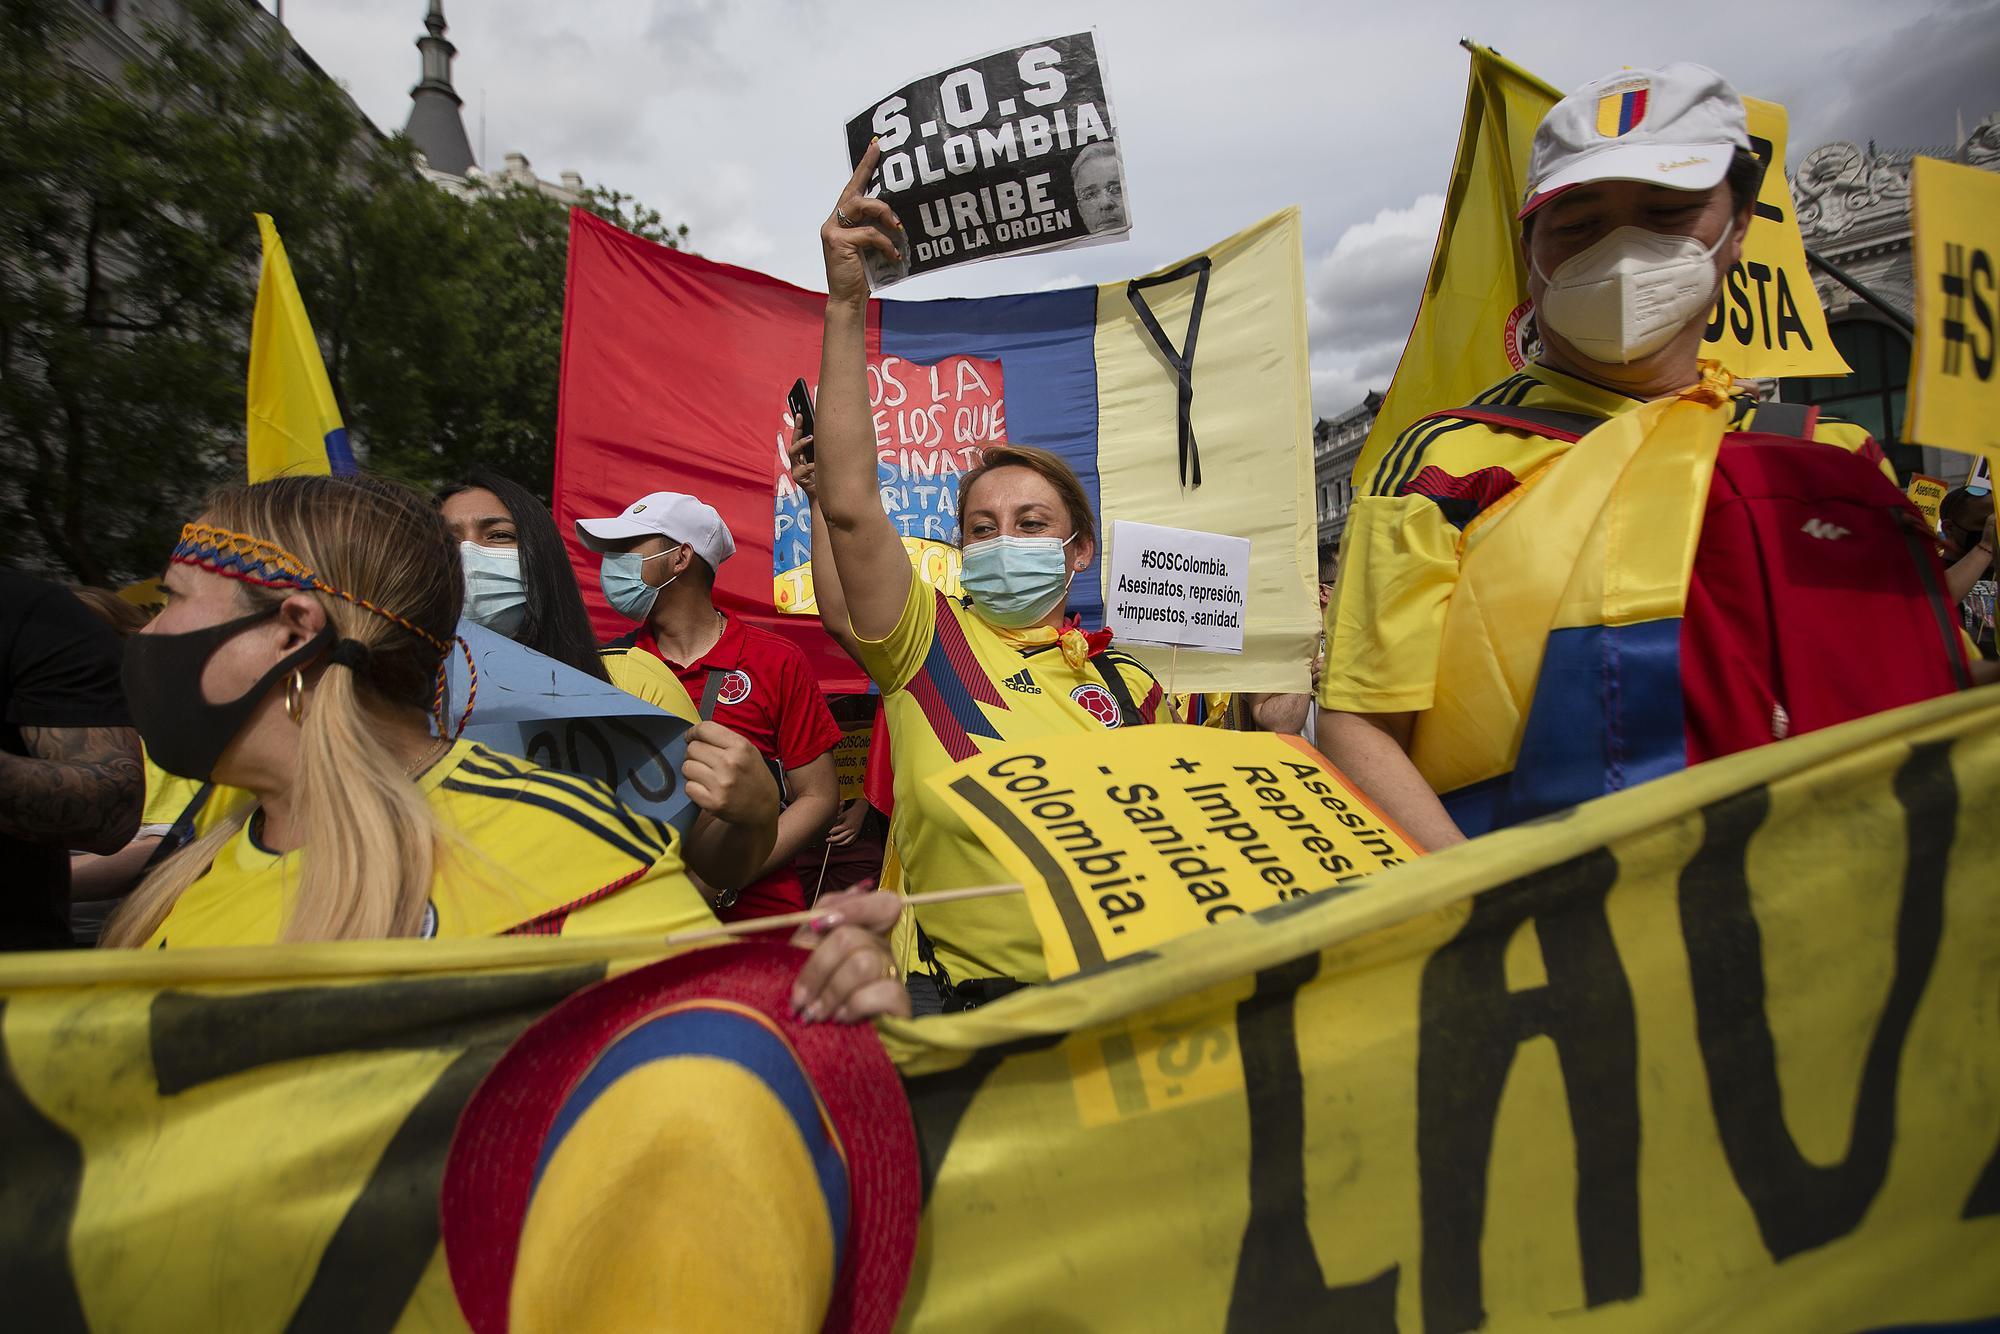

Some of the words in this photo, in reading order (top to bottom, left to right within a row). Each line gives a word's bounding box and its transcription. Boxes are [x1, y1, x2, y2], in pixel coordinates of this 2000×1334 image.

[872, 46, 1068, 152] S.O.S
[919, 173, 1056, 238] URIBE
[916, 237, 955, 262] DIO
[960, 228, 991, 251] LA
[999, 209, 1072, 243] ORDEN
[929, 359, 990, 402] LA
[899, 404, 947, 448] LOS
[953, 398, 1005, 443] QUE
[1141, 549, 1229, 577] #SOSColombia.
[1117, 574, 1186, 600] Asesinatos,
[1189, 585, 1243, 607] represión,
[1117, 601, 1188, 627] +impuestos,
[1190, 609, 1240, 628] -sanidad.
[987, 754, 1147, 936] Colombia.
